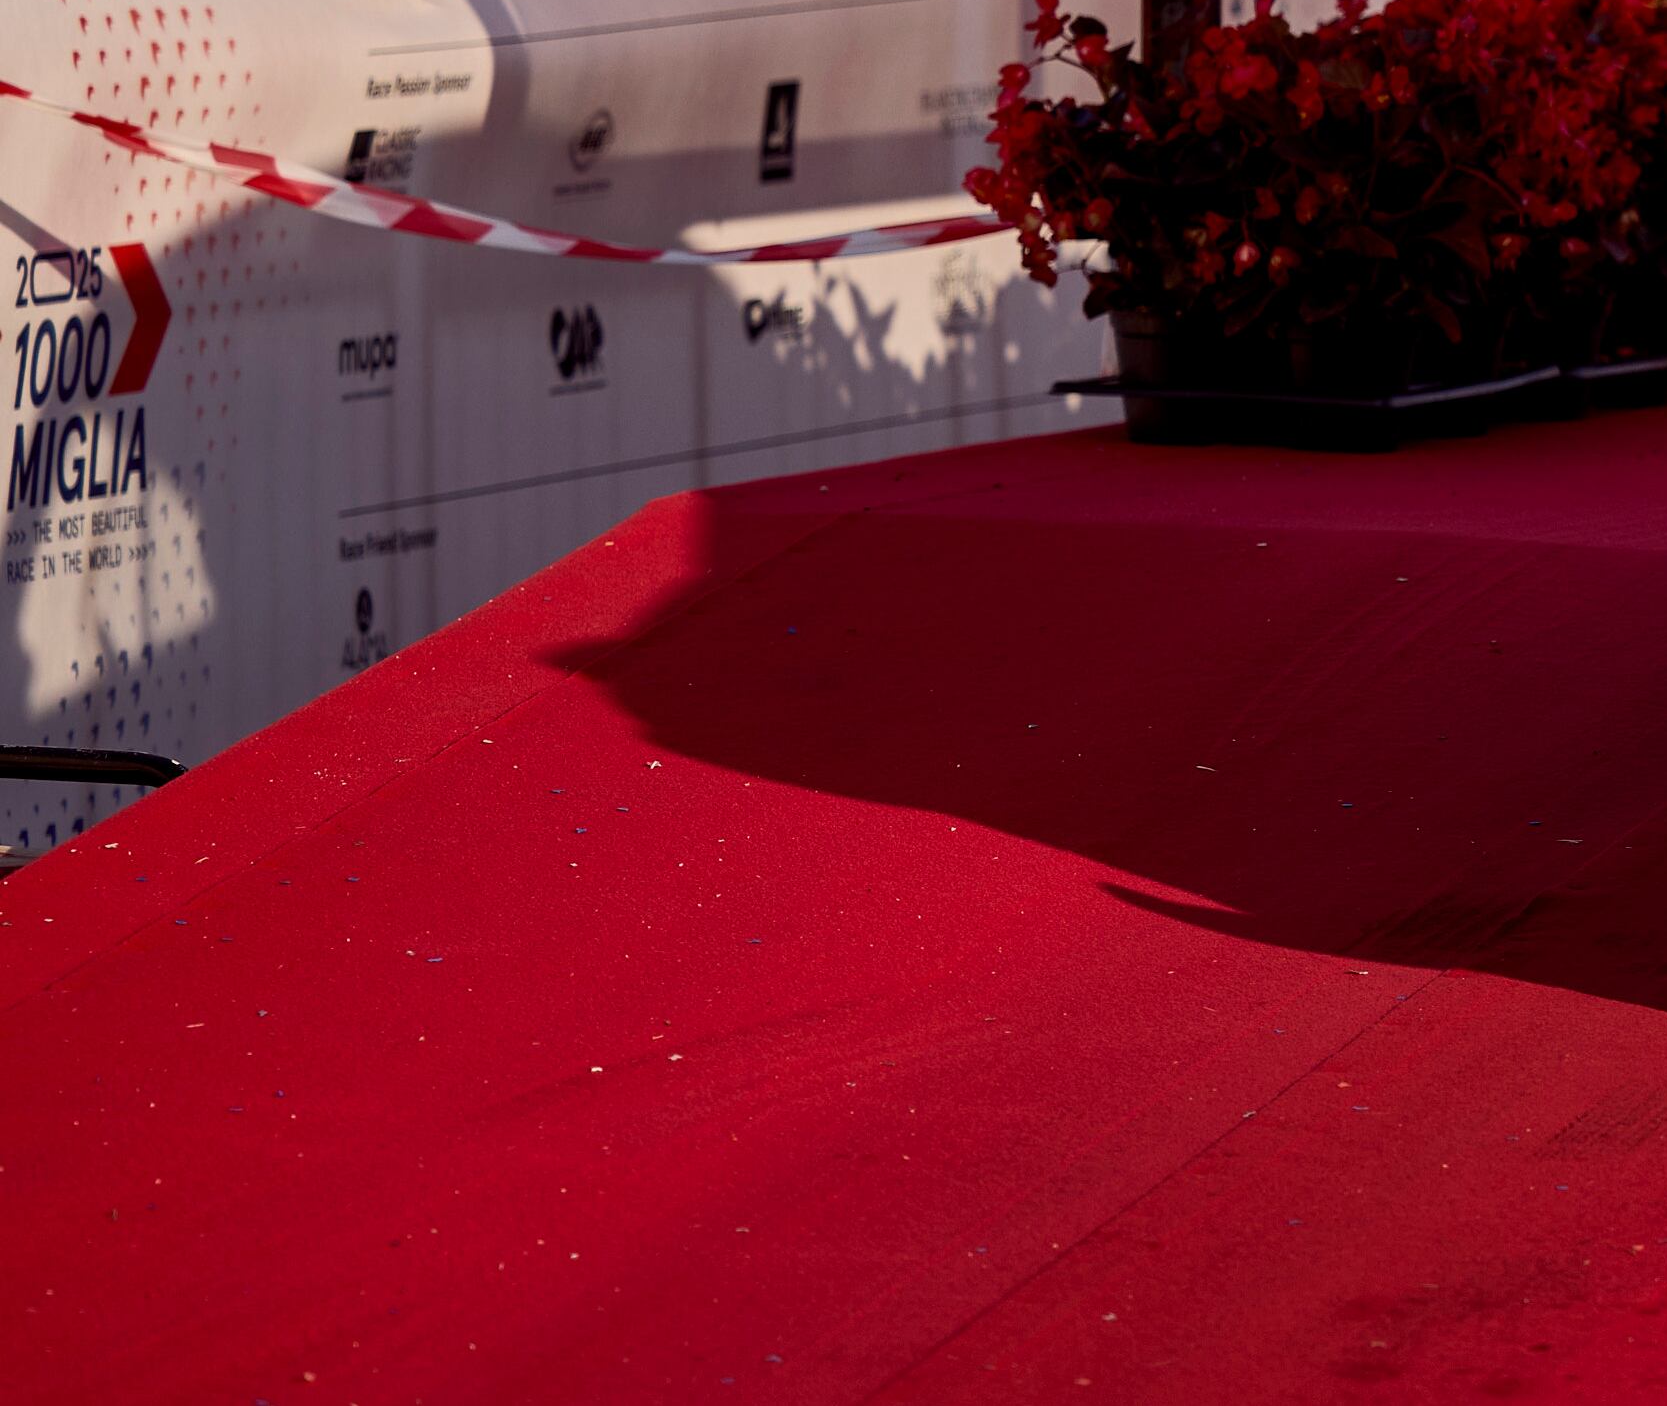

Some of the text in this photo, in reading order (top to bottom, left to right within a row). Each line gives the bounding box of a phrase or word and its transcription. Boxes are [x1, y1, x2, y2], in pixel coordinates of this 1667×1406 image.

[15, 247, 101, 308] 2025
[14, 312, 110, 410] 1000
[7, 405, 148, 512] MIGLIA
[33, 506, 148, 543] THE MOST BEAUTIFUL
[7, 544, 122, 584] RACE IN THE WORLD
